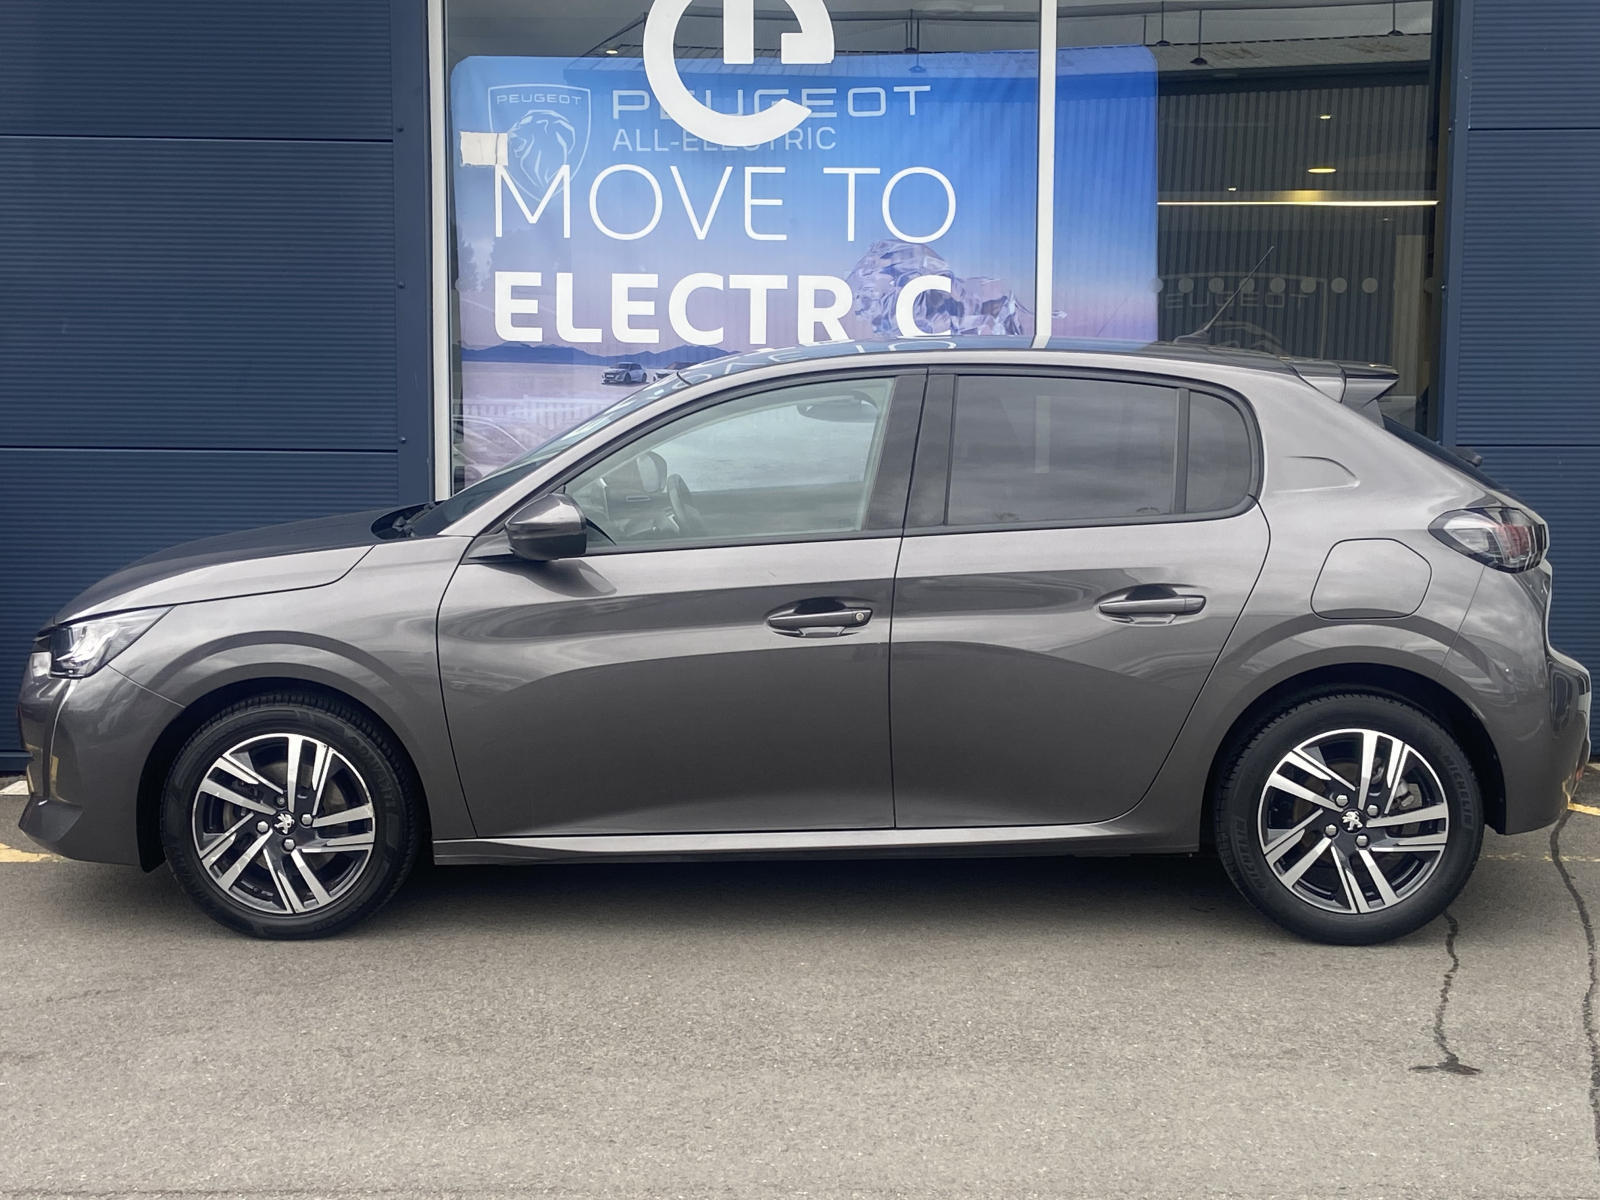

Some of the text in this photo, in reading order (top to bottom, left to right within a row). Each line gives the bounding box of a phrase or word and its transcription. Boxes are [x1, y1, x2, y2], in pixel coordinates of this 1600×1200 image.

[496, 93, 582, 106] PEUGEOT
[612, 85, 932, 120] PUGEOT
[494, 163, 957, 244] MOVE TO
[494, 270, 953, 346] ELECTRC
[1164, 290, 1310, 310] EUGEOT
[1441, 754, 1474, 827] MICHELIN
